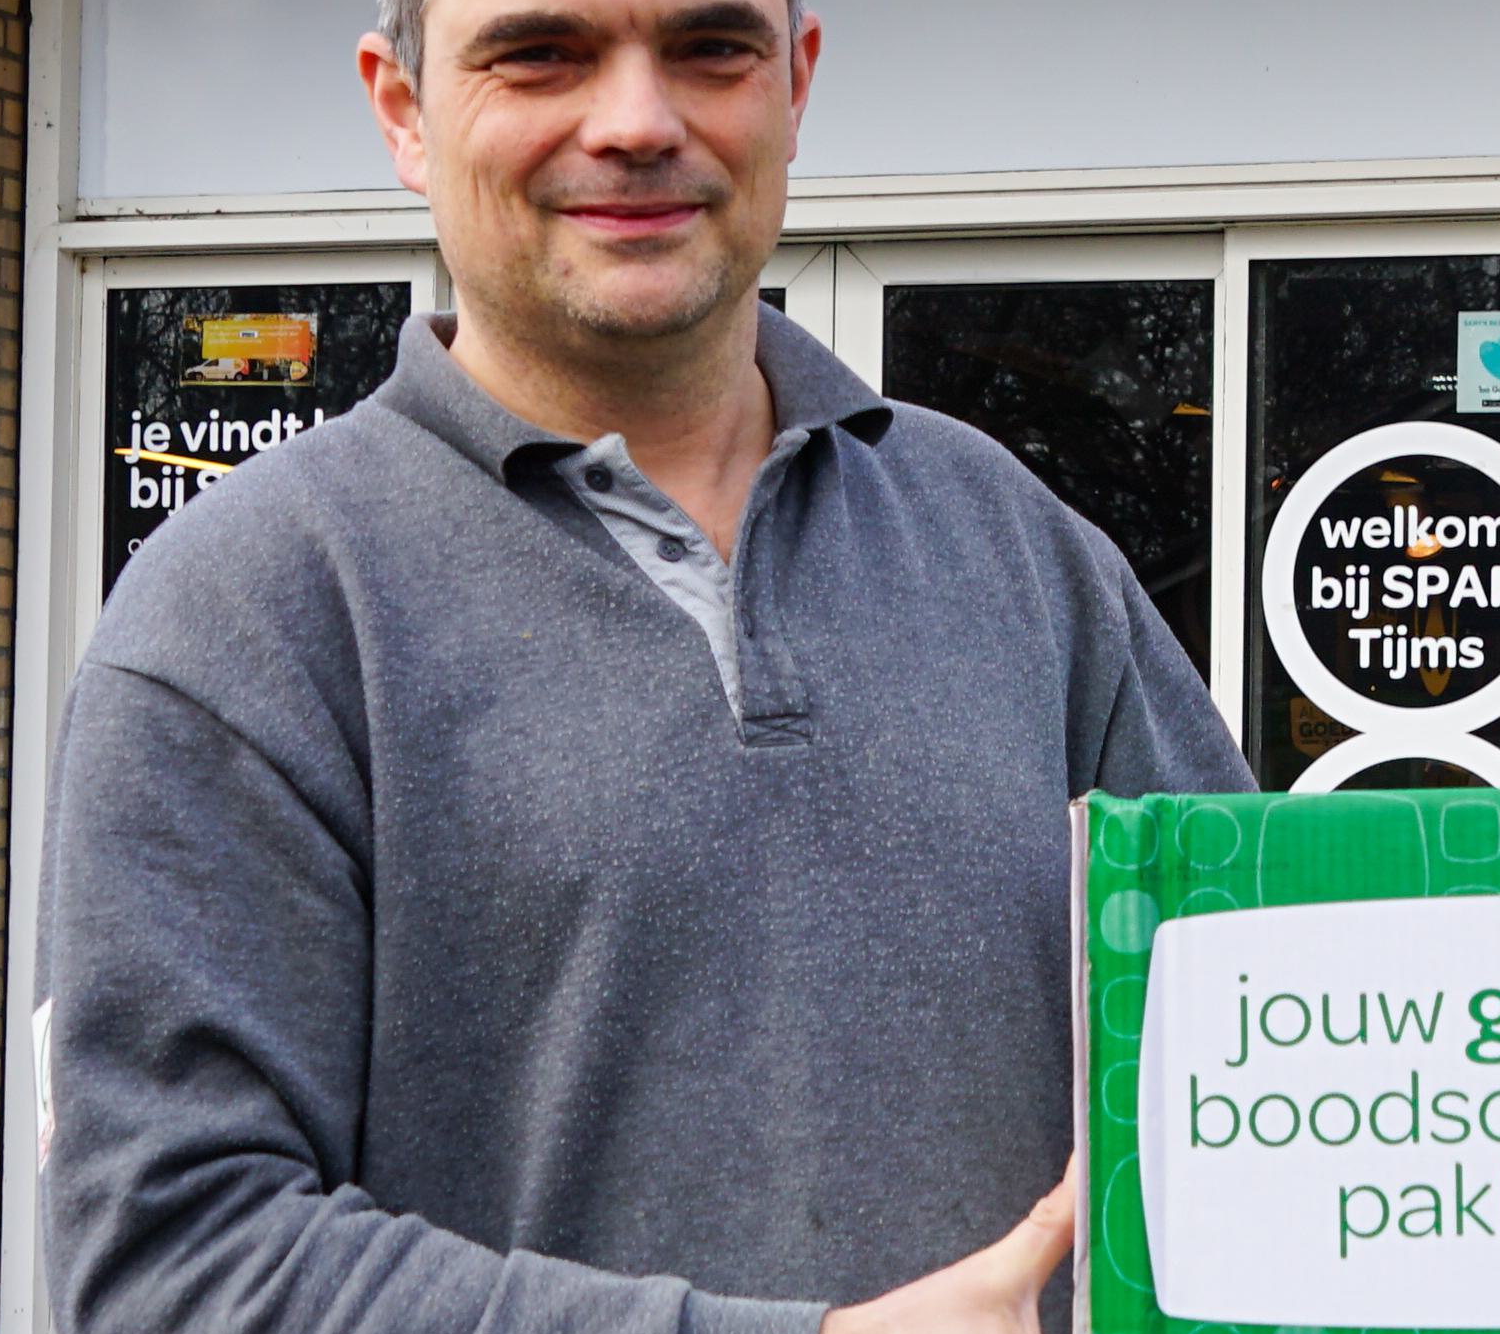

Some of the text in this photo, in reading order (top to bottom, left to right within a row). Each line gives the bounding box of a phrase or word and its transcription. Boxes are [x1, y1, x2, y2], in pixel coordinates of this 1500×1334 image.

[124, 411, 170, 463] je
[180, 409, 304, 453] vindt
[129, 466, 185, 515] bij
[1311, 567, 1371, 619] bij
[1349, 626, 1485, 680] Tijms
[1224, 973, 1443, 1067] jouw
